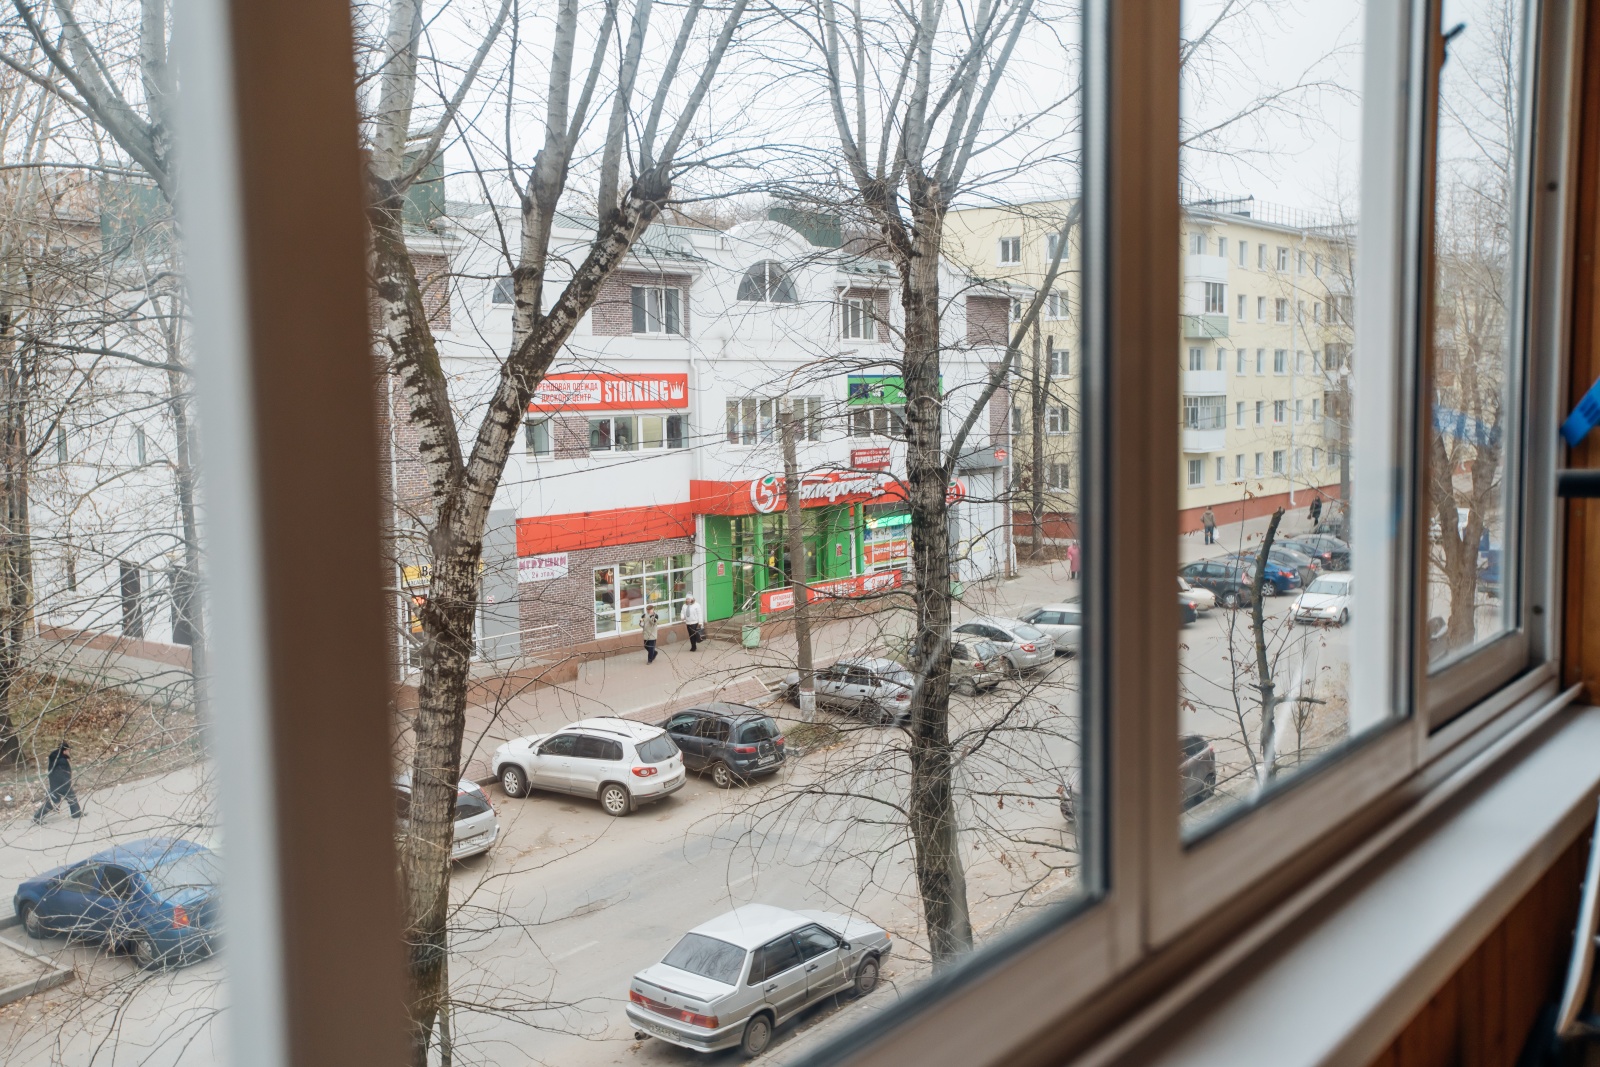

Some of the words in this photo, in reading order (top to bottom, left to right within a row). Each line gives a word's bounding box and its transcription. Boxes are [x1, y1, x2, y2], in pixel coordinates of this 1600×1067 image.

[535, 382, 571, 391] РЕНДОВАЯ
[572, 382, 598, 391] ОДЕЖДА
[518, 556, 567, 571] ИГРУШКИ
